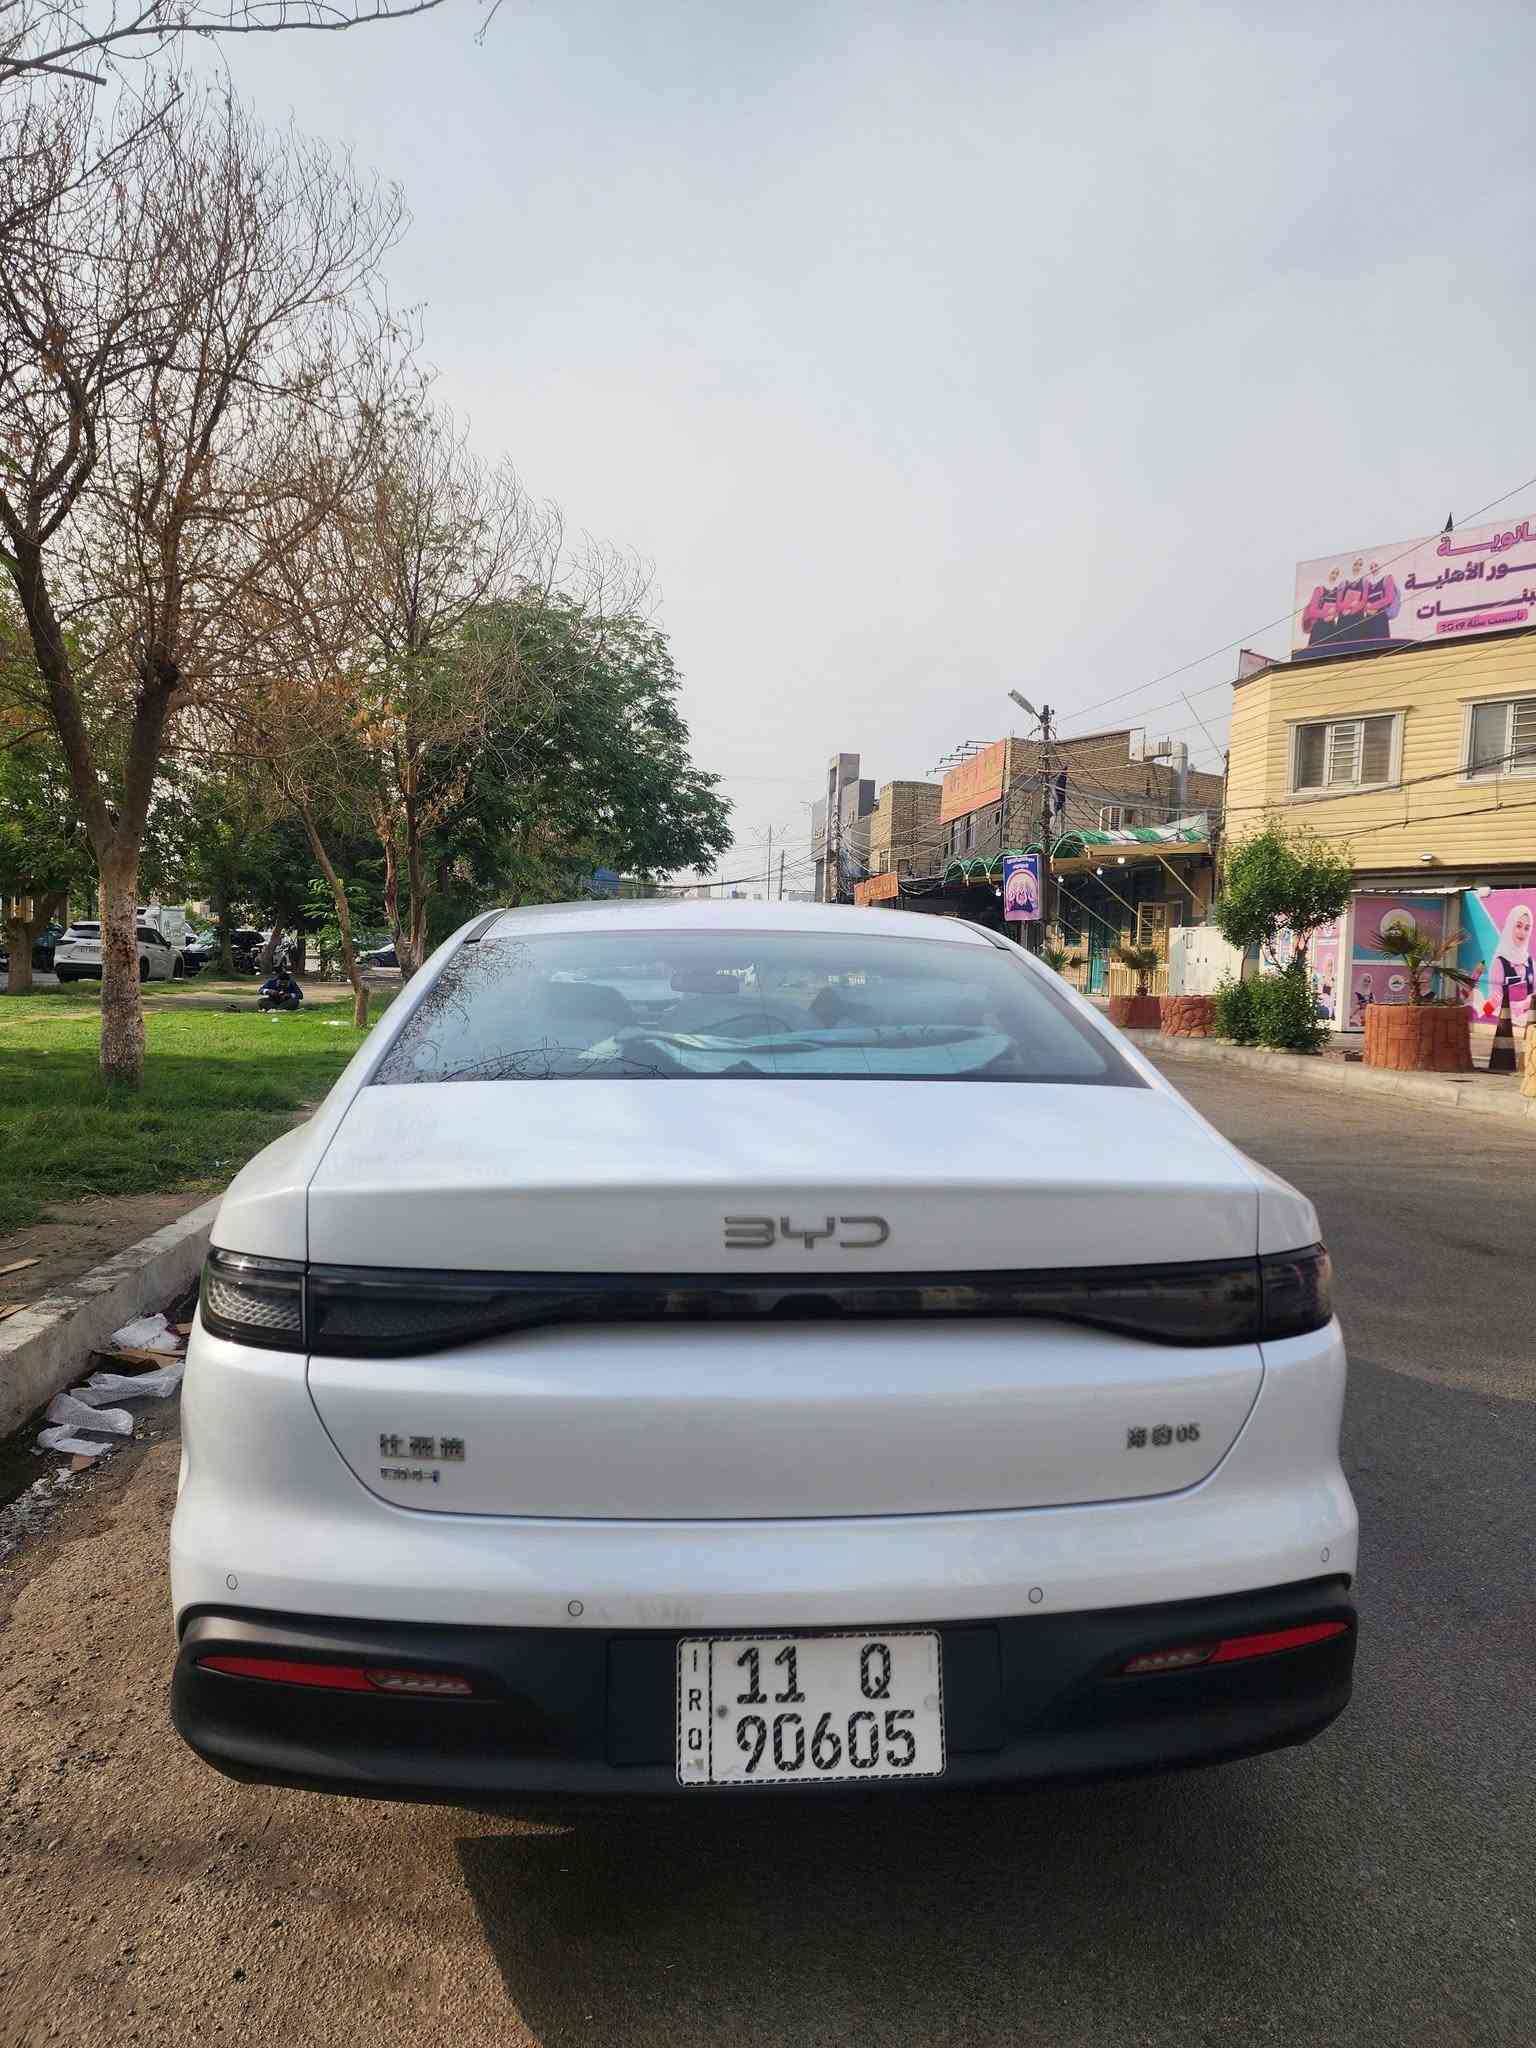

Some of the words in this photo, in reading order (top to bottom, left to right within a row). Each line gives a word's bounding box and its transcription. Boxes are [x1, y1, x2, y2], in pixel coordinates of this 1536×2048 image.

[1436, 521, 1536, 557] انوية
[1404, 561, 1484, 591] الأهلية
[1486, 562, 1536, 581] ور
[1416, 587, 1536, 619] بنات
[725, 1216, 890, 1249] BYD
[736, 1646, 806, 1704] 11
[859, 1642, 890, 1700] Q
[736, 1709, 916, 1774] 90605
